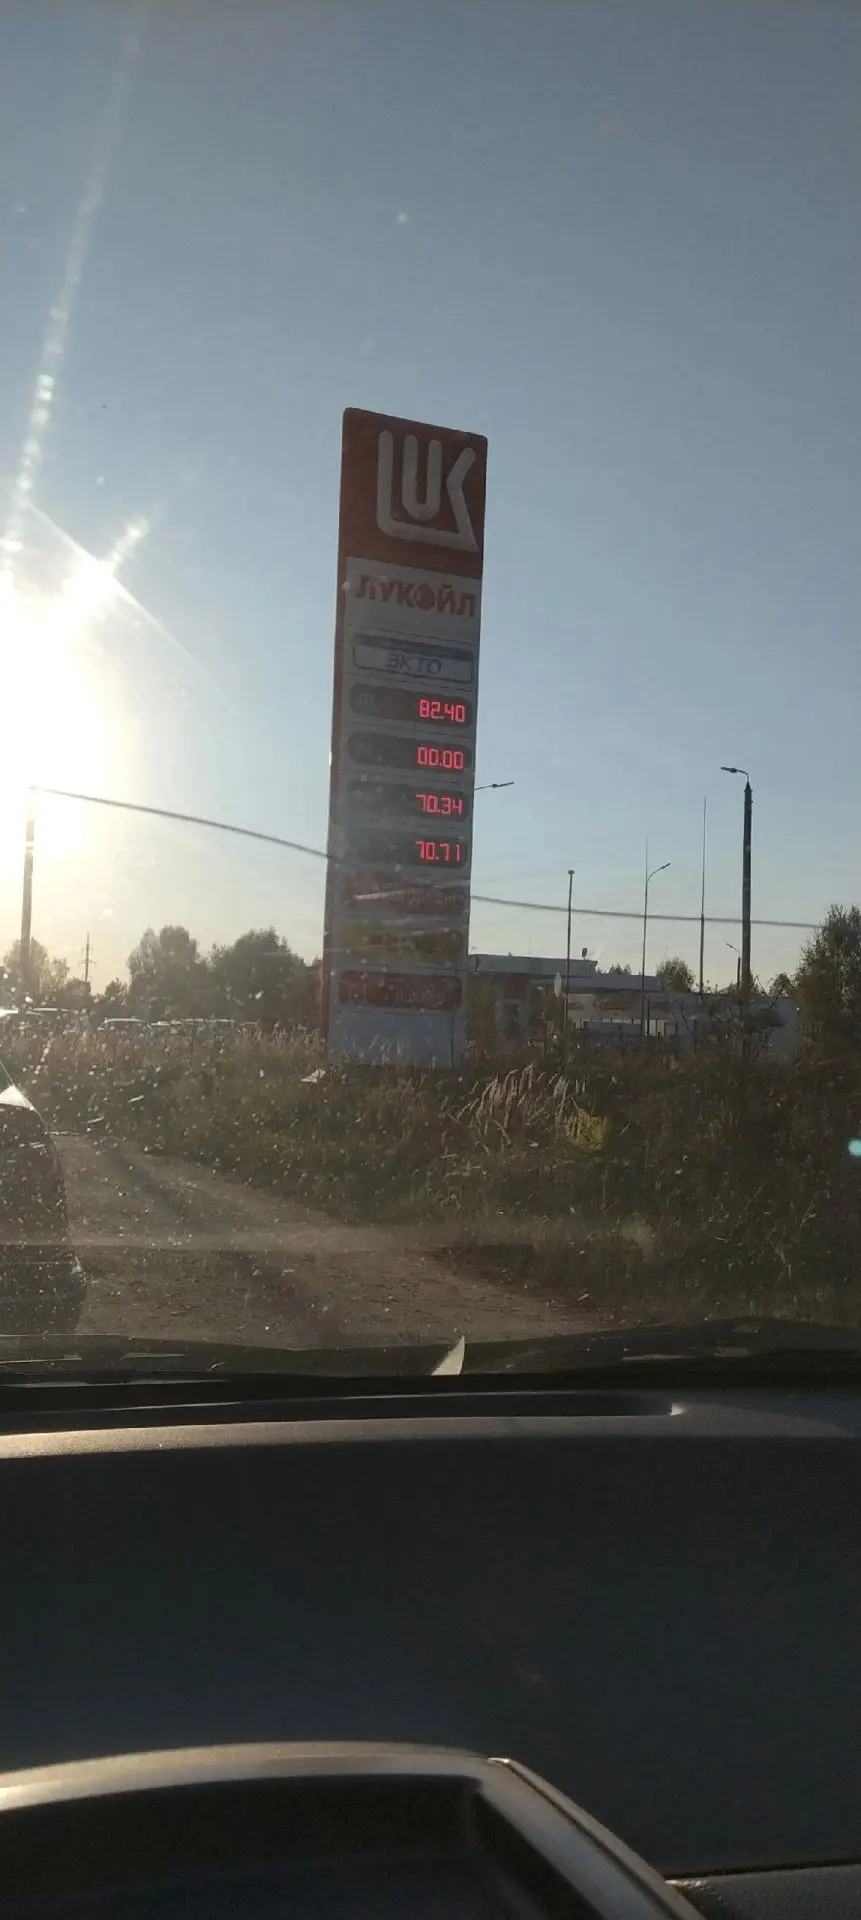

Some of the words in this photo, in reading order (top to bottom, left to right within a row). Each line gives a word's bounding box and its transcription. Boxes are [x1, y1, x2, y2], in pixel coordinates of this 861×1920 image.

[354, 574, 476, 618] ЛУКОЙЛ
[385, 652, 442, 674] ЭКТО
[418, 698, 467, 723] 82.40
[417, 746, 464, 770] 00.00
[415, 793, 463, 815] 70.34
[415, 840, 460, 862] 70.71
